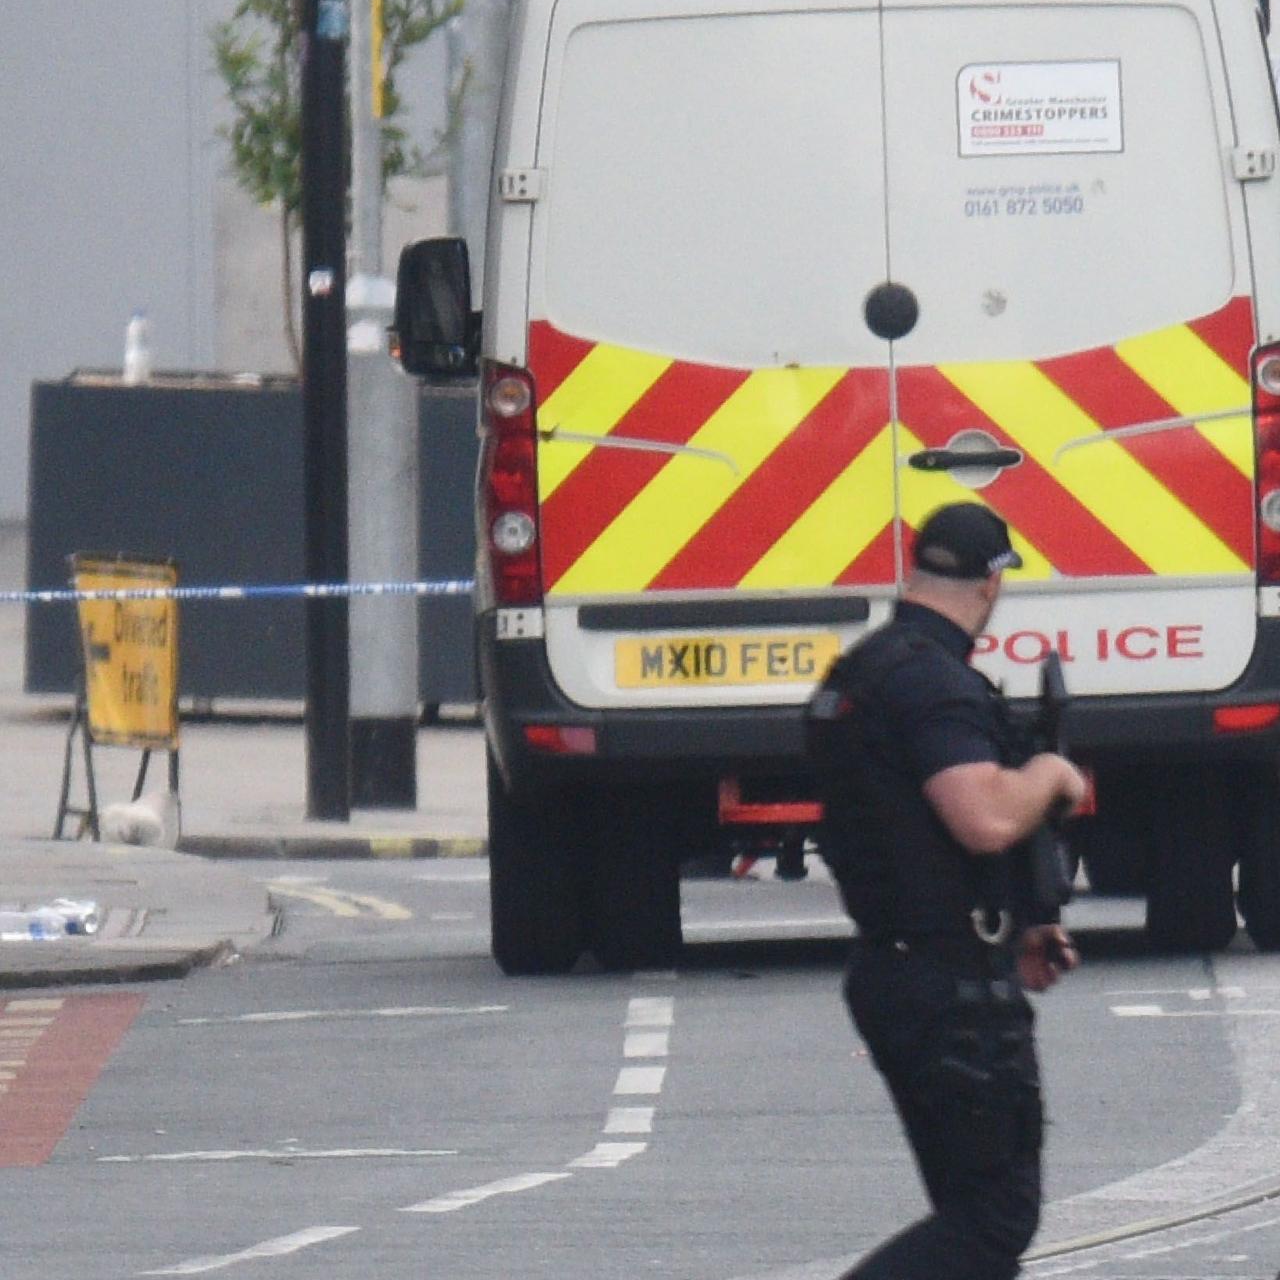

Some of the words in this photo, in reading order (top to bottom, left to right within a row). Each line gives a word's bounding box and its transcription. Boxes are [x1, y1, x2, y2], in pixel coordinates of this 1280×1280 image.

[971, 106, 1108, 122] CRIMESTOPPERS
[964, 199, 998, 217] 0161
[1006, 197, 1036, 216] 872
[1042, 195, 1084, 215] 5050
[641, 643, 728, 679] MX10
[740, 641, 816, 677] FEG
[965, 625, 1204, 665] POLICE
